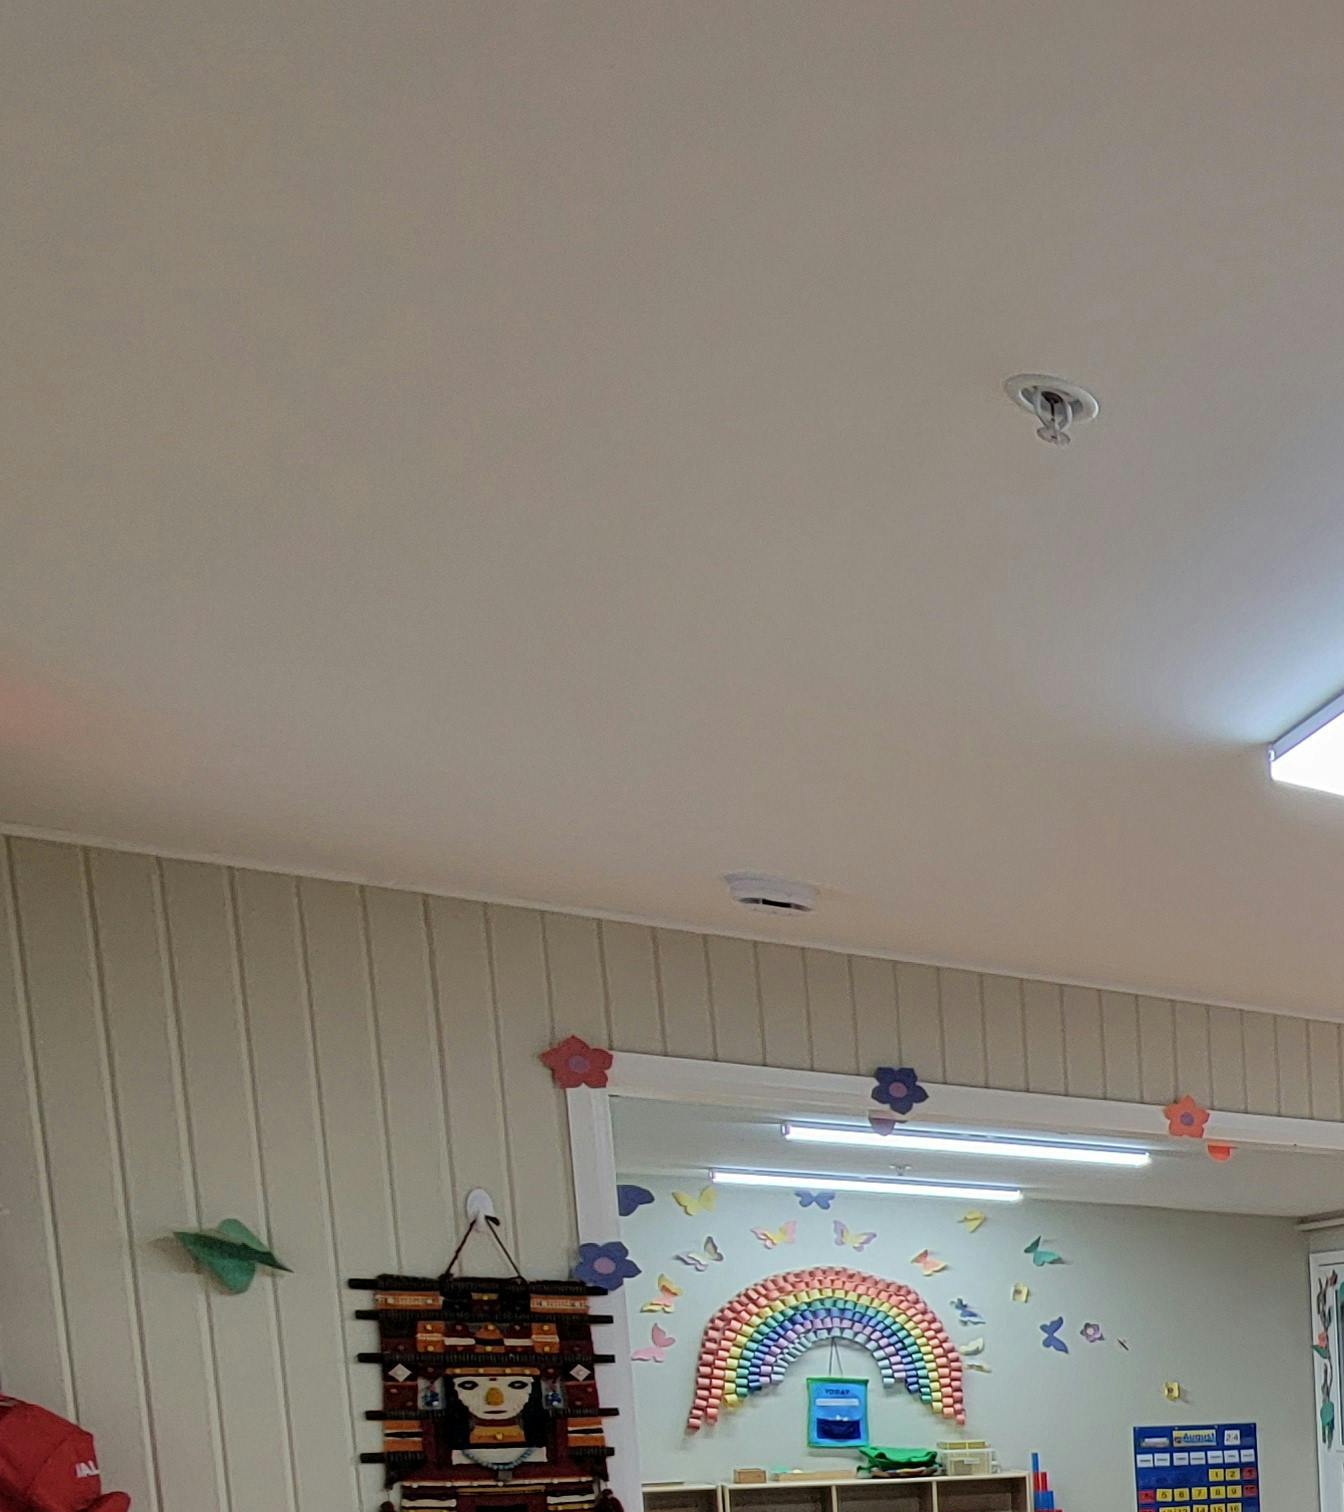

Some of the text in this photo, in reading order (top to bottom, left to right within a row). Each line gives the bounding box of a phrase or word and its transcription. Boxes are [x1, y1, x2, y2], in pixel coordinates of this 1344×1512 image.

[1183, 1432, 1215, 1443] August
[1230, 1470, 1236, 1478] 2
[1161, 1491, 1167, 1499] 5
[1178, 1490, 1185, 1498] 6
[1197, 1489, 1203, 1497] 7
[1215, 1488, 1221, 1496] 8
[1231, 1487, 1237, 1495] 9
[1229, 1505, 1239, 1512] 16
